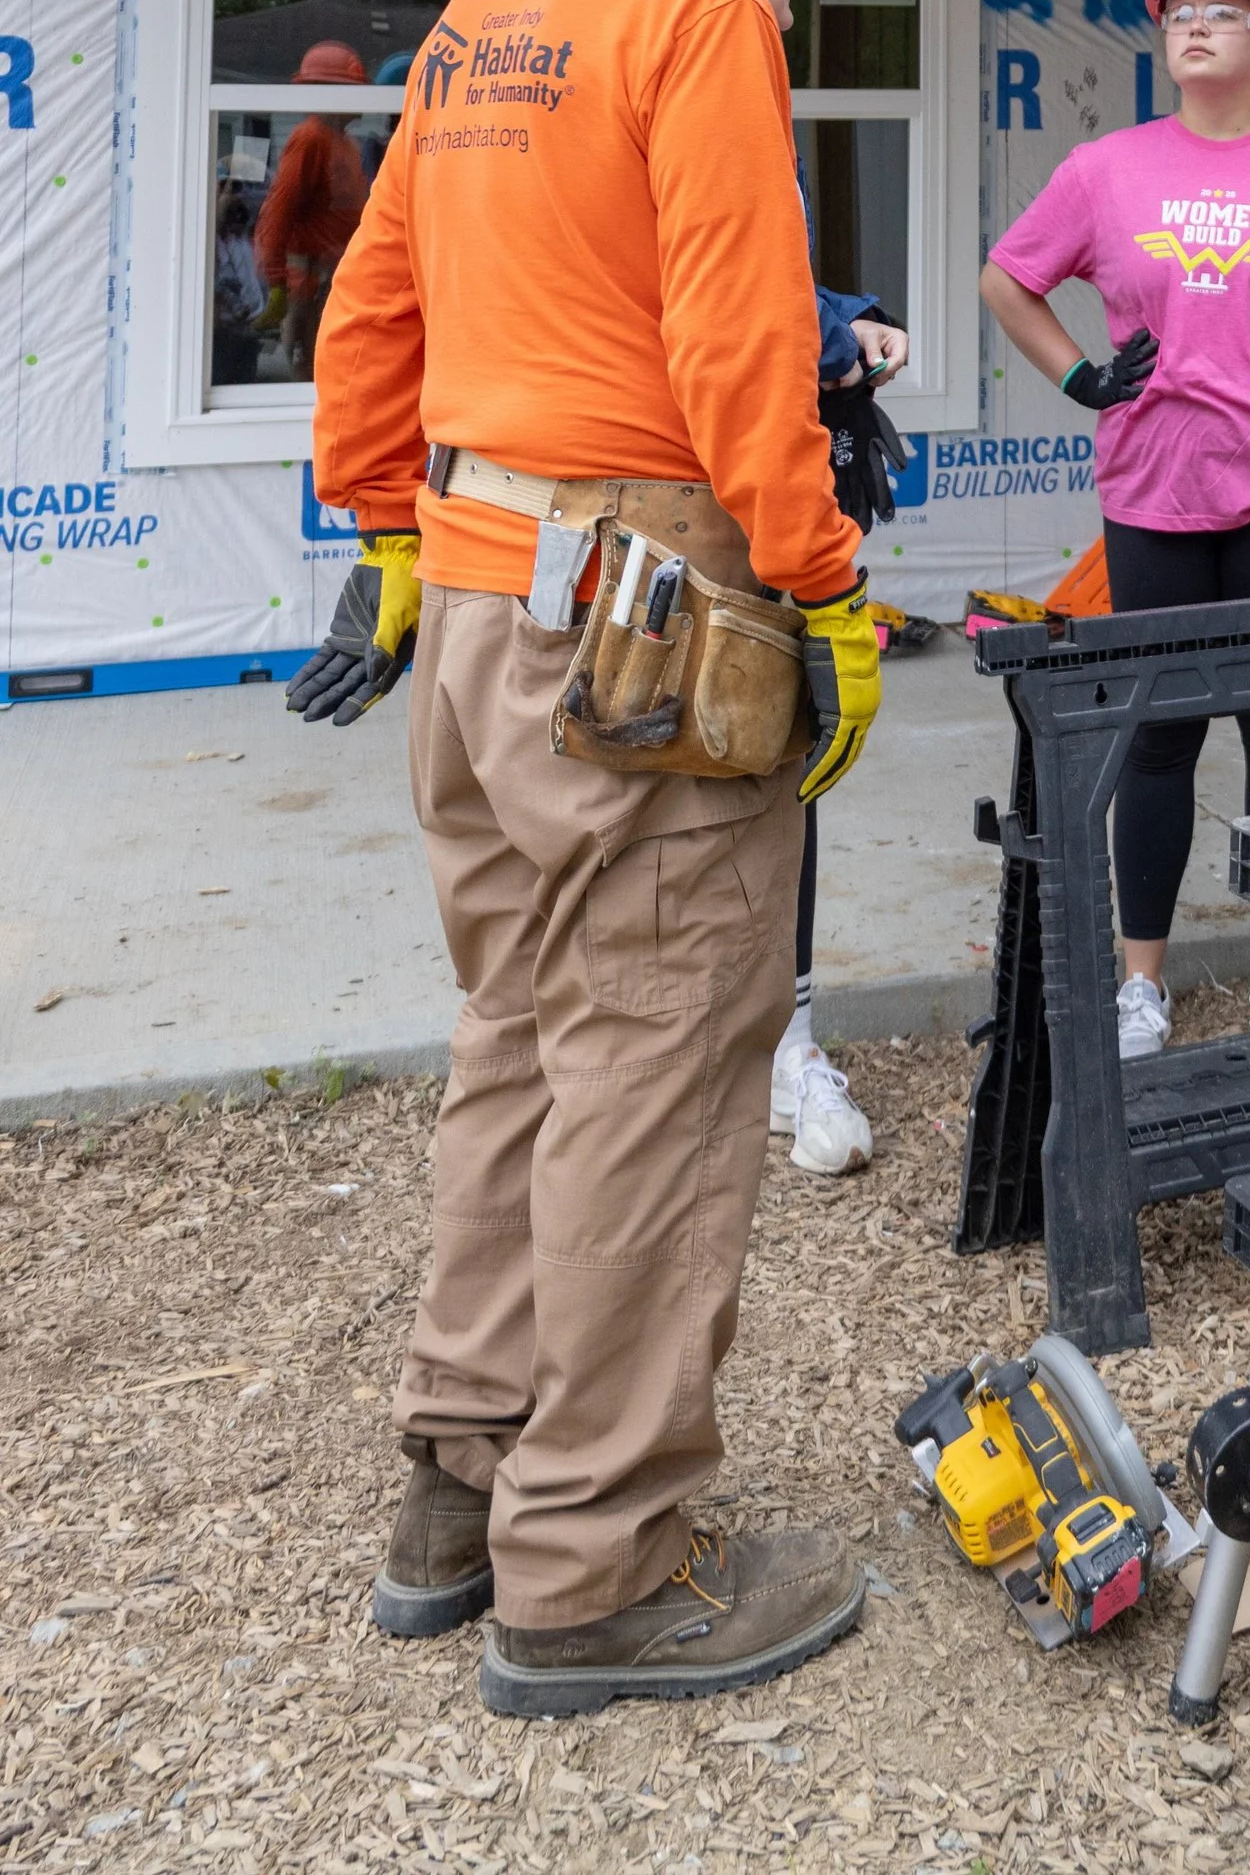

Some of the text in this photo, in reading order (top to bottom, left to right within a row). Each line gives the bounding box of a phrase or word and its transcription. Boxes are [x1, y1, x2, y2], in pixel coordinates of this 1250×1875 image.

[482, 7, 545, 31] Greater Indy
[470, 33, 573, 79] Habitat
[465, 83, 485, 106] for
[997, 49, 1043, 130] R
[415, 124, 529, 156] indyhabitat.org
[1182, 224, 1241, 246] BUILD
[932, 466, 1059, 499] BUILDING
[57, 514, 158, 550] WRAP
